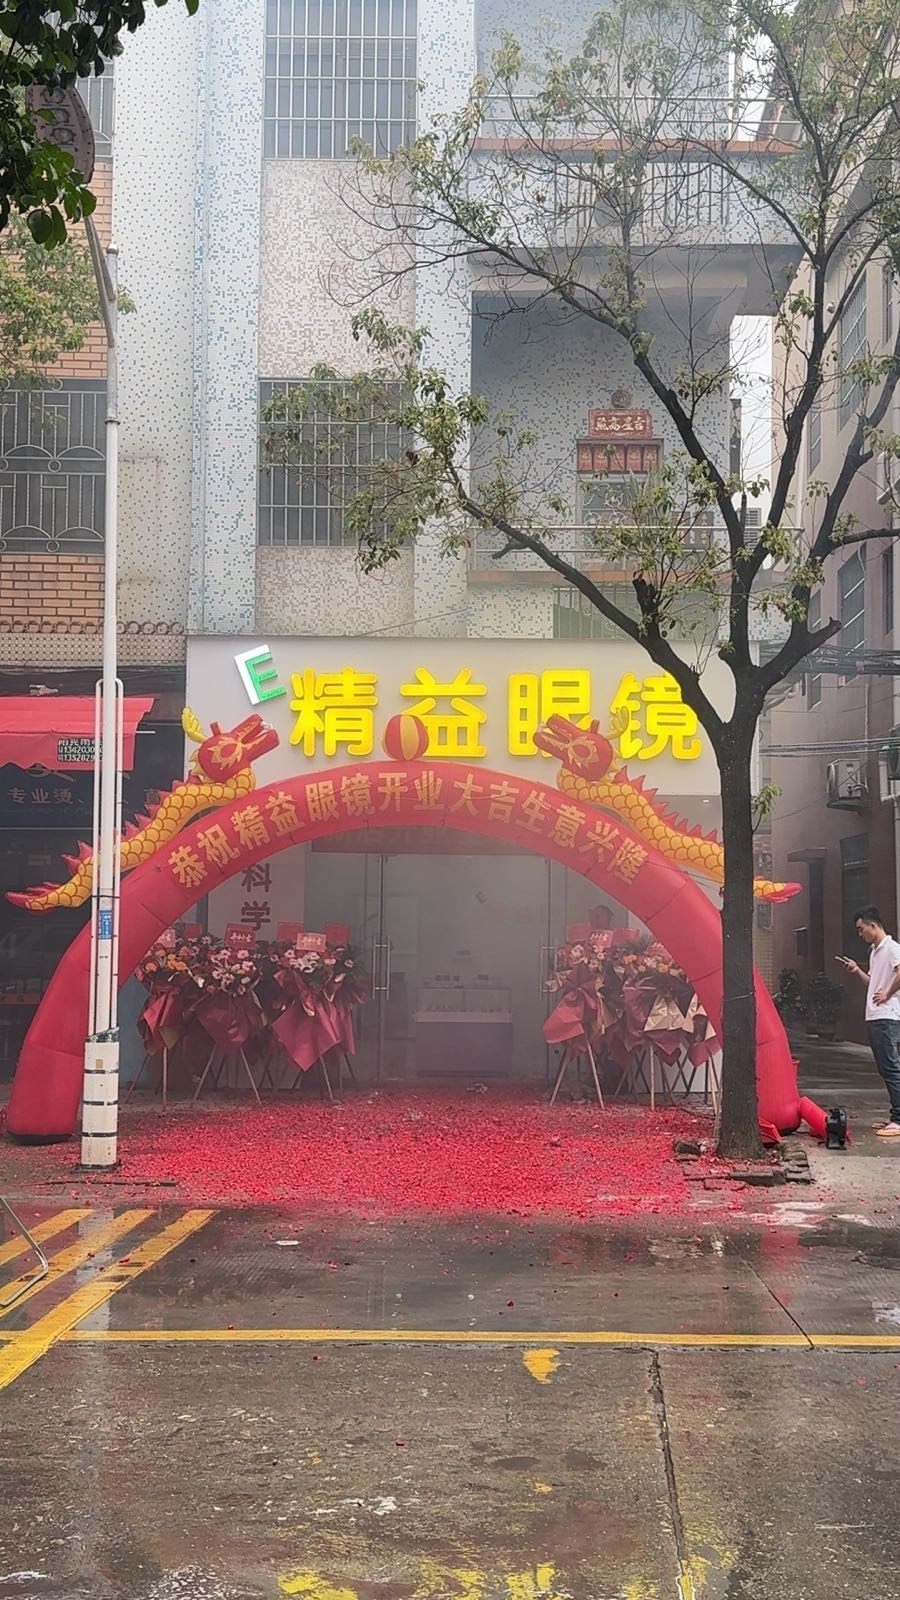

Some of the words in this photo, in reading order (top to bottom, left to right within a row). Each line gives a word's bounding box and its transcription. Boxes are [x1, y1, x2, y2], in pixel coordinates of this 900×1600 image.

[234, 643, 287, 706] E
[289, 665, 702, 761] 精益眼镜
[168, 770, 648, 888] 恭祝精益眼镜开业大吉生意兴隆
[241, 863, 272, 944] 科学
